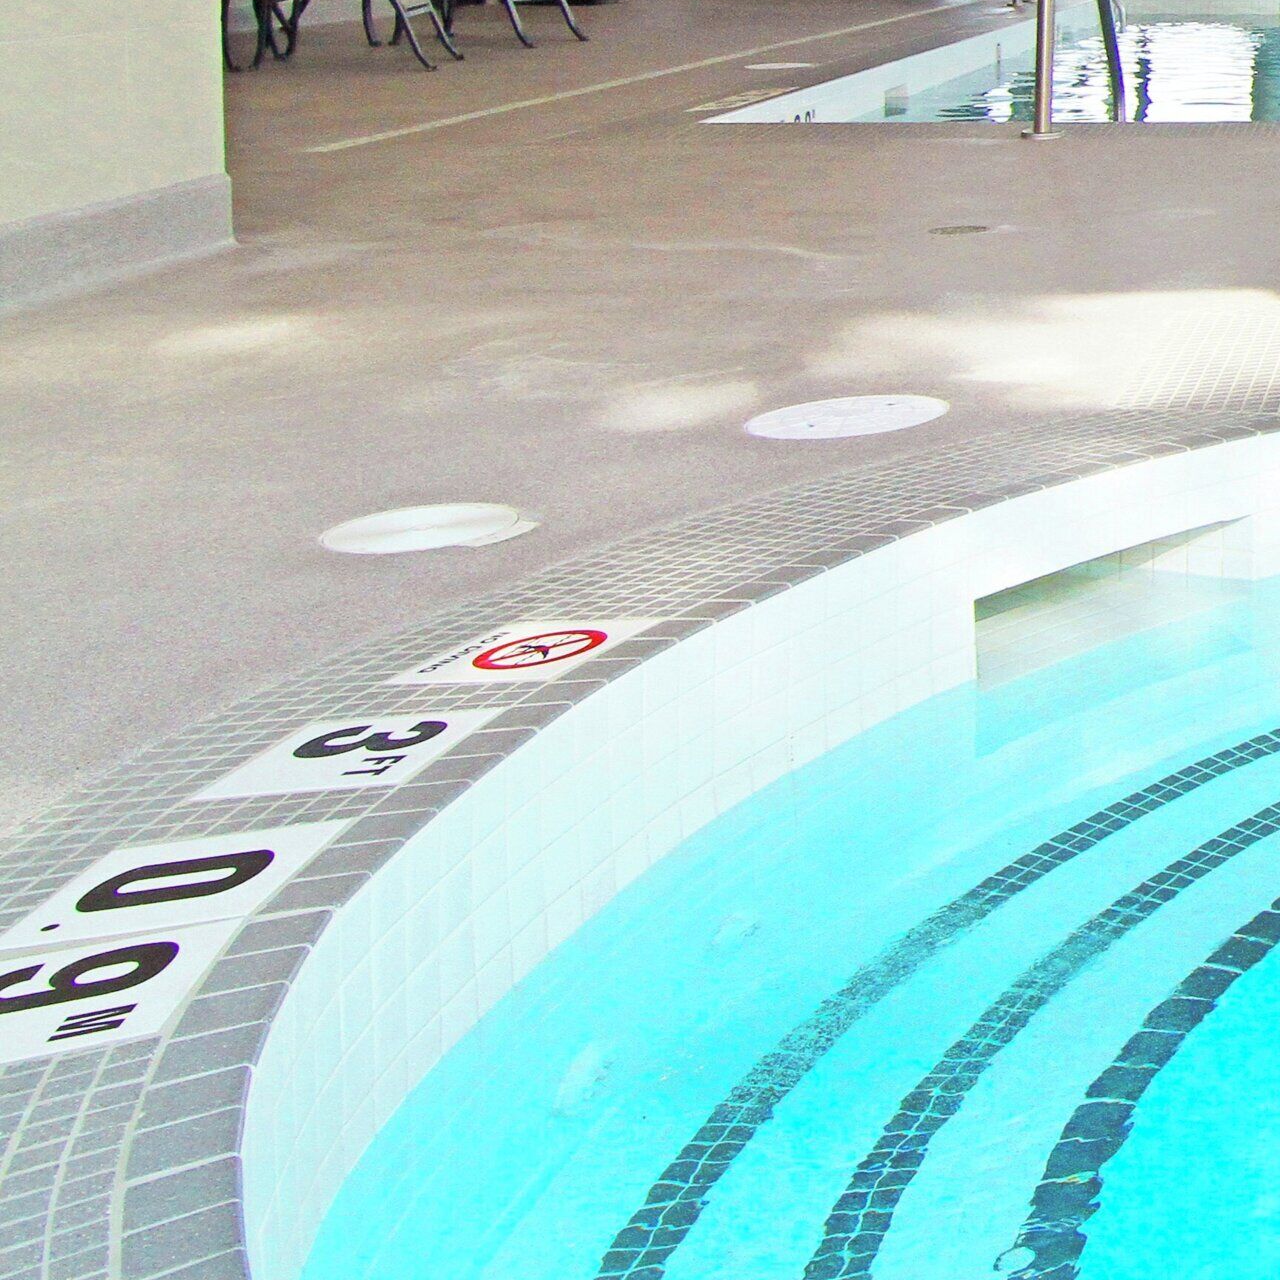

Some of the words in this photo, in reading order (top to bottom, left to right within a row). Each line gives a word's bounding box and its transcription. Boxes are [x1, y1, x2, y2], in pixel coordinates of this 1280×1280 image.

[293, 720, 448, 759] 3
[341, 754, 408, 776] FT
[46, 1002, 139, 1042] M
